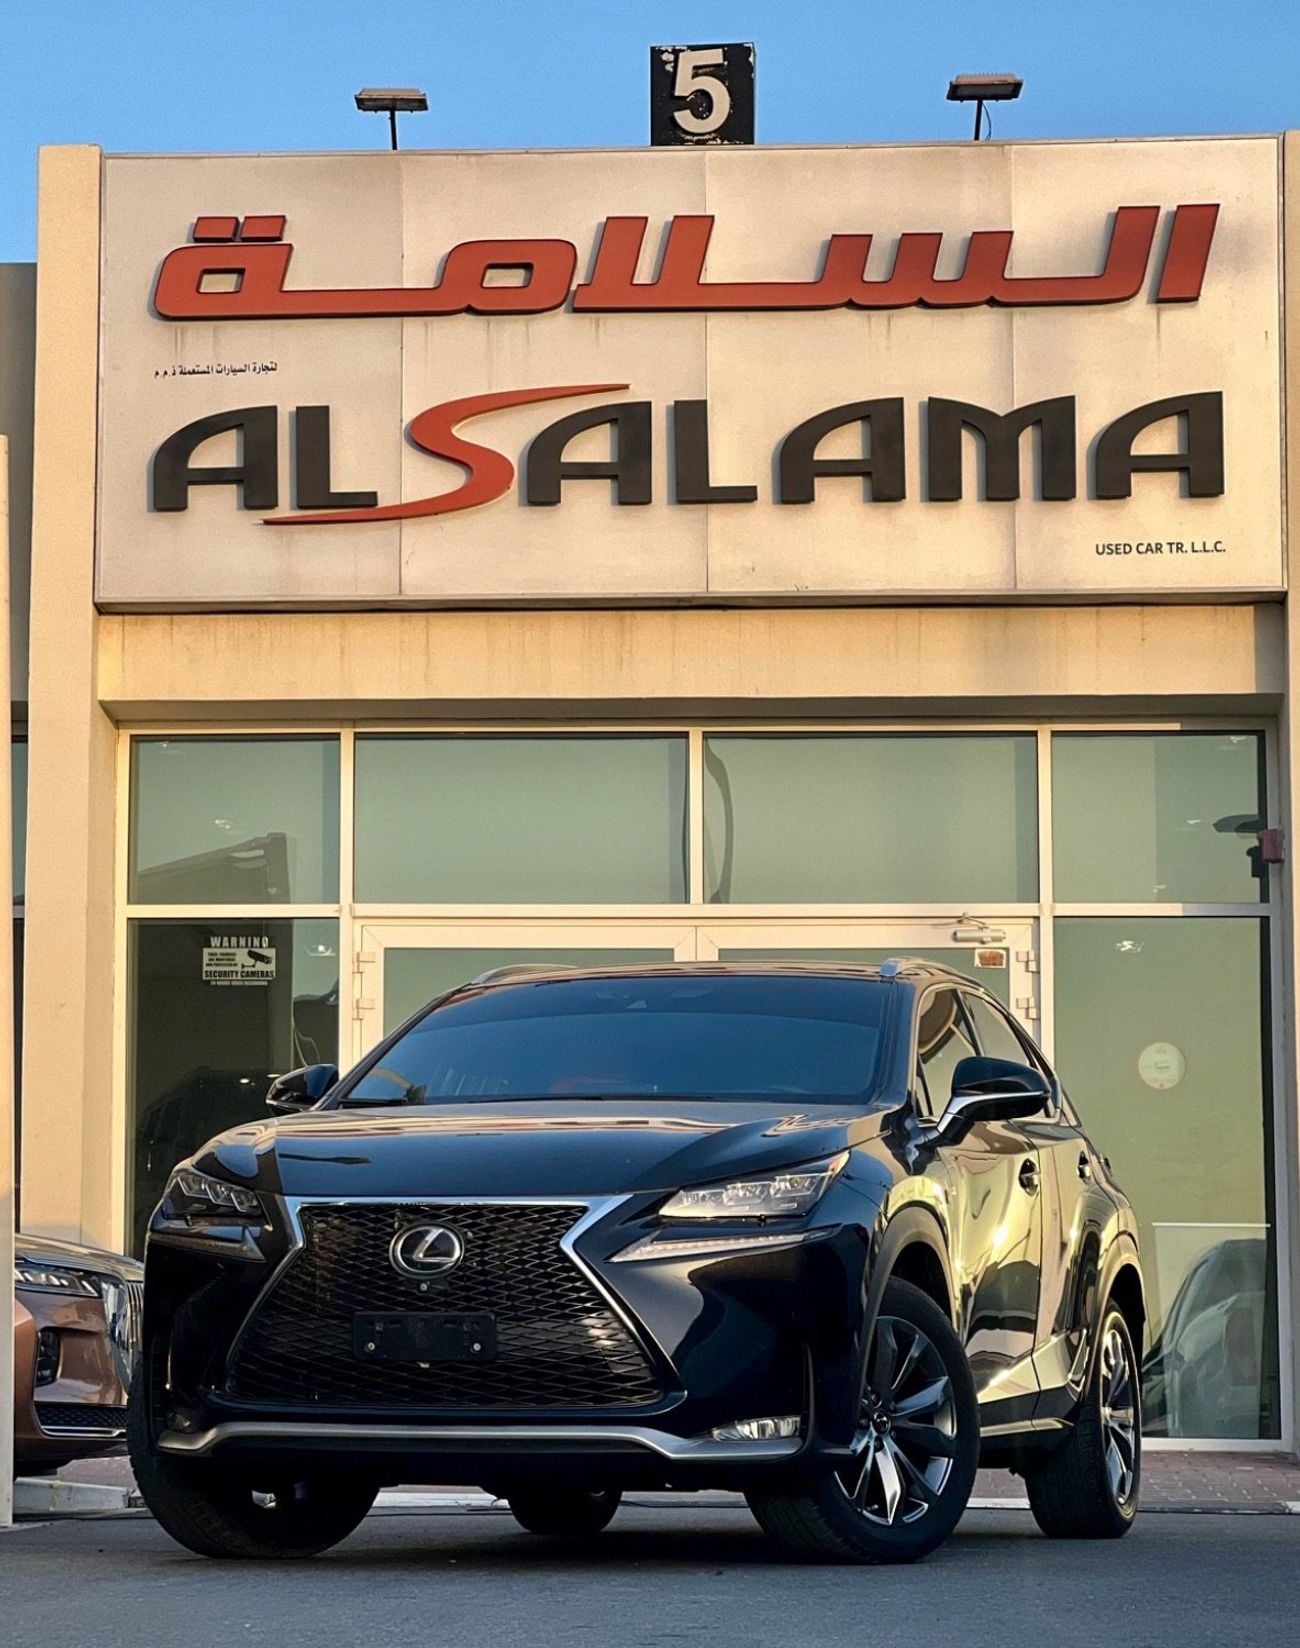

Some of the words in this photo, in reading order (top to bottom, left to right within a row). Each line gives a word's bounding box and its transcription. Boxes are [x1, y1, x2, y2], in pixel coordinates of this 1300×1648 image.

[673, 48, 731, 134] 5
[153, 203, 1220, 318] السلامة
[179, 364, 213, 376] المستعملة
[216, 362, 250, 376] السيارات
[252, 360, 278, 375] لتجارة
[152, 384, 1225, 525] ALSALAMA
[1095, 542, 1132, 556] USED
[1135, 541, 1164, 555] CAR
[1166, 540, 1188, 554] TR.
[1190, 540, 1227, 554] L.L.C.
[204, 970, 239, 978] SECURITY
[240, 970, 274, 978] CAMERAS
